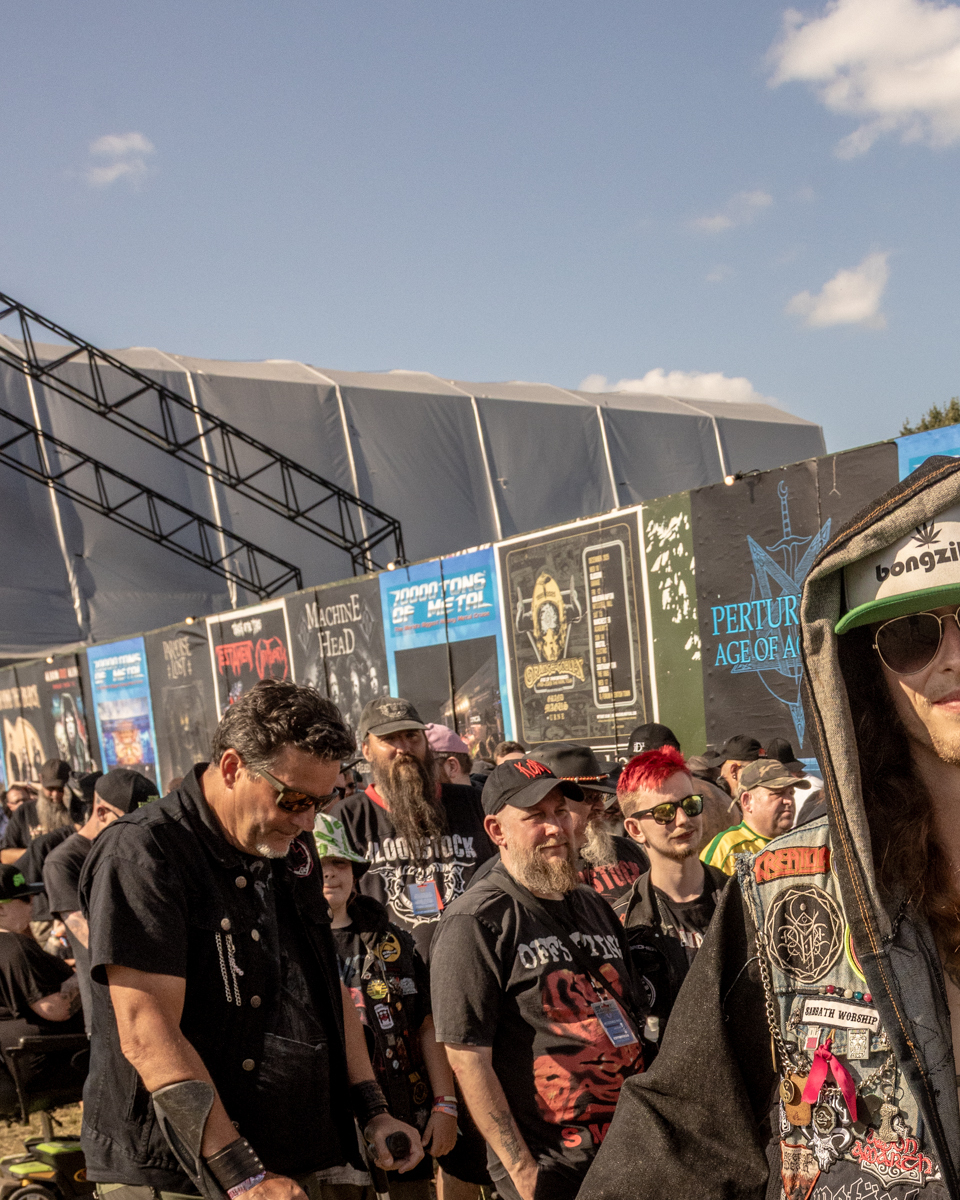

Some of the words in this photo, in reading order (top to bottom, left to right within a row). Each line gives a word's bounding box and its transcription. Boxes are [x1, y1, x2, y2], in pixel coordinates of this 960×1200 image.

[389, 581, 438, 607] 70000
[439, 571, 486, 597] TONS
[305, 593, 362, 630] MACHINE
[392, 605, 415, 624] OF
[427, 590, 493, 618] METAL
[318, 628, 355, 658] HEAD
[715, 641, 751, 667] AGE
[754, 637, 778, 662] OF
[753, 845, 831, 884] KREATOR
[805, 1006, 835, 1018] SABBATH
[838, 1010, 878, 1026] WORSHIP
